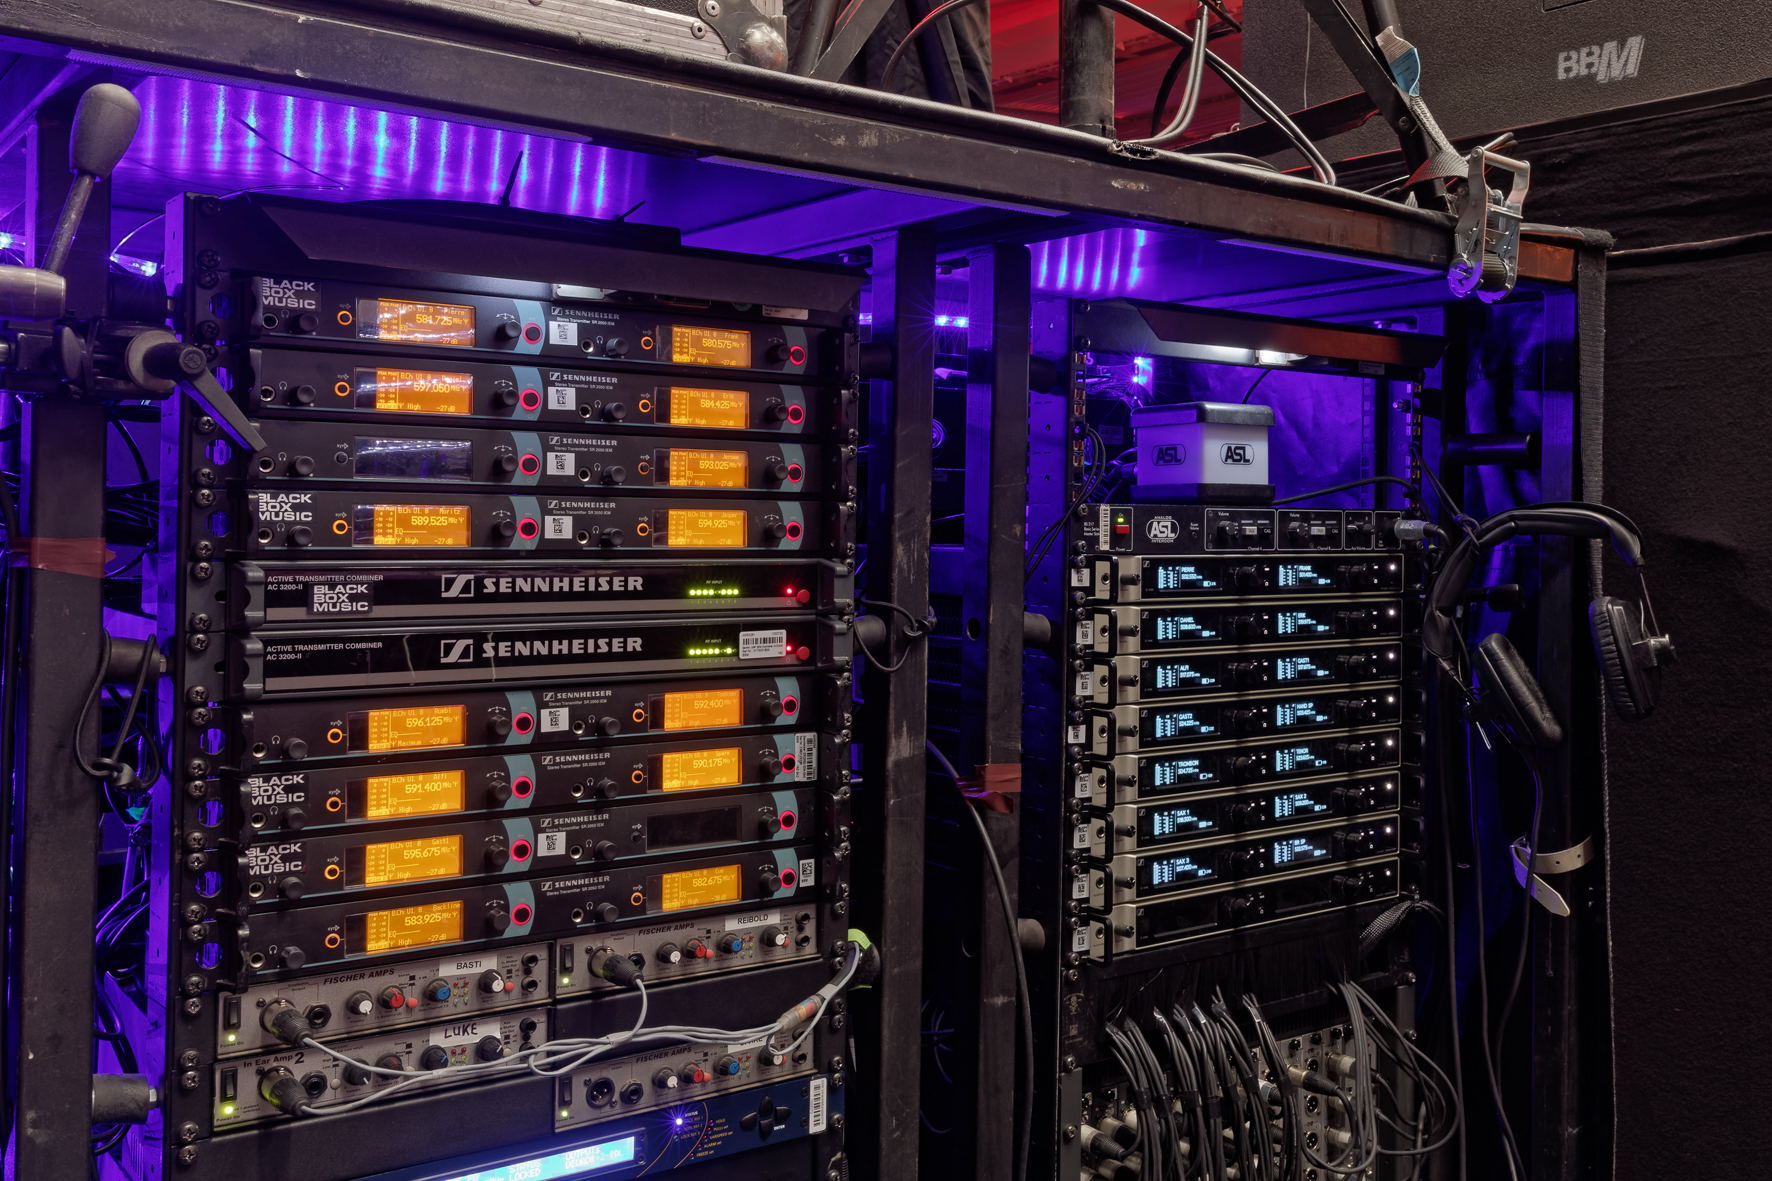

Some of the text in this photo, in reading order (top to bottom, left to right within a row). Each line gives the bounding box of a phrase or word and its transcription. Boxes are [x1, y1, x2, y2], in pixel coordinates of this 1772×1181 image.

[1557, 35, 1645, 83] BBM
[262, 278, 315, 291] BLACK
[262, 287, 296, 298] BOX
[262, 296, 316, 309] MUSIC
[416, 313, 453, 326] 584.725
[564, 309, 620, 320] SENNHEISER
[702, 338, 732, 349] 580.575
[562, 374, 618, 384] SENNHEISER
[414, 383, 450, 393] 597.050
[562, 438, 618, 446] SENNHEISER
[1155, 446, 1182, 465] ASL
[1224, 445, 1251, 463] ASL
[699, 460, 729, 470] 593.025
[258, 493, 312, 504] BLACK
[258, 502, 293, 512] BOX
[561, 501, 616, 509] SENNHEISER
[258, 511, 313, 521] MUSIC
[411, 516, 448, 526] 589.525
[1150, 521, 1176, 538] ASL
[313, 584, 369, 594] BLACK
[483, 576, 644, 593] SENNHEISER
[313, 593, 350, 603] BOX
[313, 602, 369, 612] MUSIC
[266, 645, 293, 653] ACTIVE
[482, 637, 643, 658] SENNHEISER
[556, 690, 612, 699] SENNHEISER
[406, 716, 443, 728] 596.125
[555, 752, 611, 763] SENNHEISER
[693, 758, 723, 769] 590.175
[249, 774, 305, 787] BLACK
[251, 785, 285, 796] BOX
[405, 782, 442, 794] 591.400
[251, 793, 305, 805] MUSIC
[554, 813, 609, 825] SENNHEISER
[247, 843, 302, 857] BLACK
[403, 846, 440, 860] 595.675
[249, 854, 283, 867] BOX
[249, 861, 302, 876] MUSIC
[554, 875, 610, 888] SENNHEISER
[404, 912, 441, 926] 583.925
[736, 914, 768, 925] REIBOLD
[637, 922, 695, 936] FISCHER AMPS
[456, 960, 482, 970] BASTI
[323, 967, 395, 985] FISCHER AMPS
[444, 1022, 478, 1039] LUKE
[255, 1058, 271, 1066] Ear
[273, 1055, 293, 1063] Amp
[294, 1051, 305, 1065] 2
[636, 1046, 692, 1064] FISCHER AMPS
